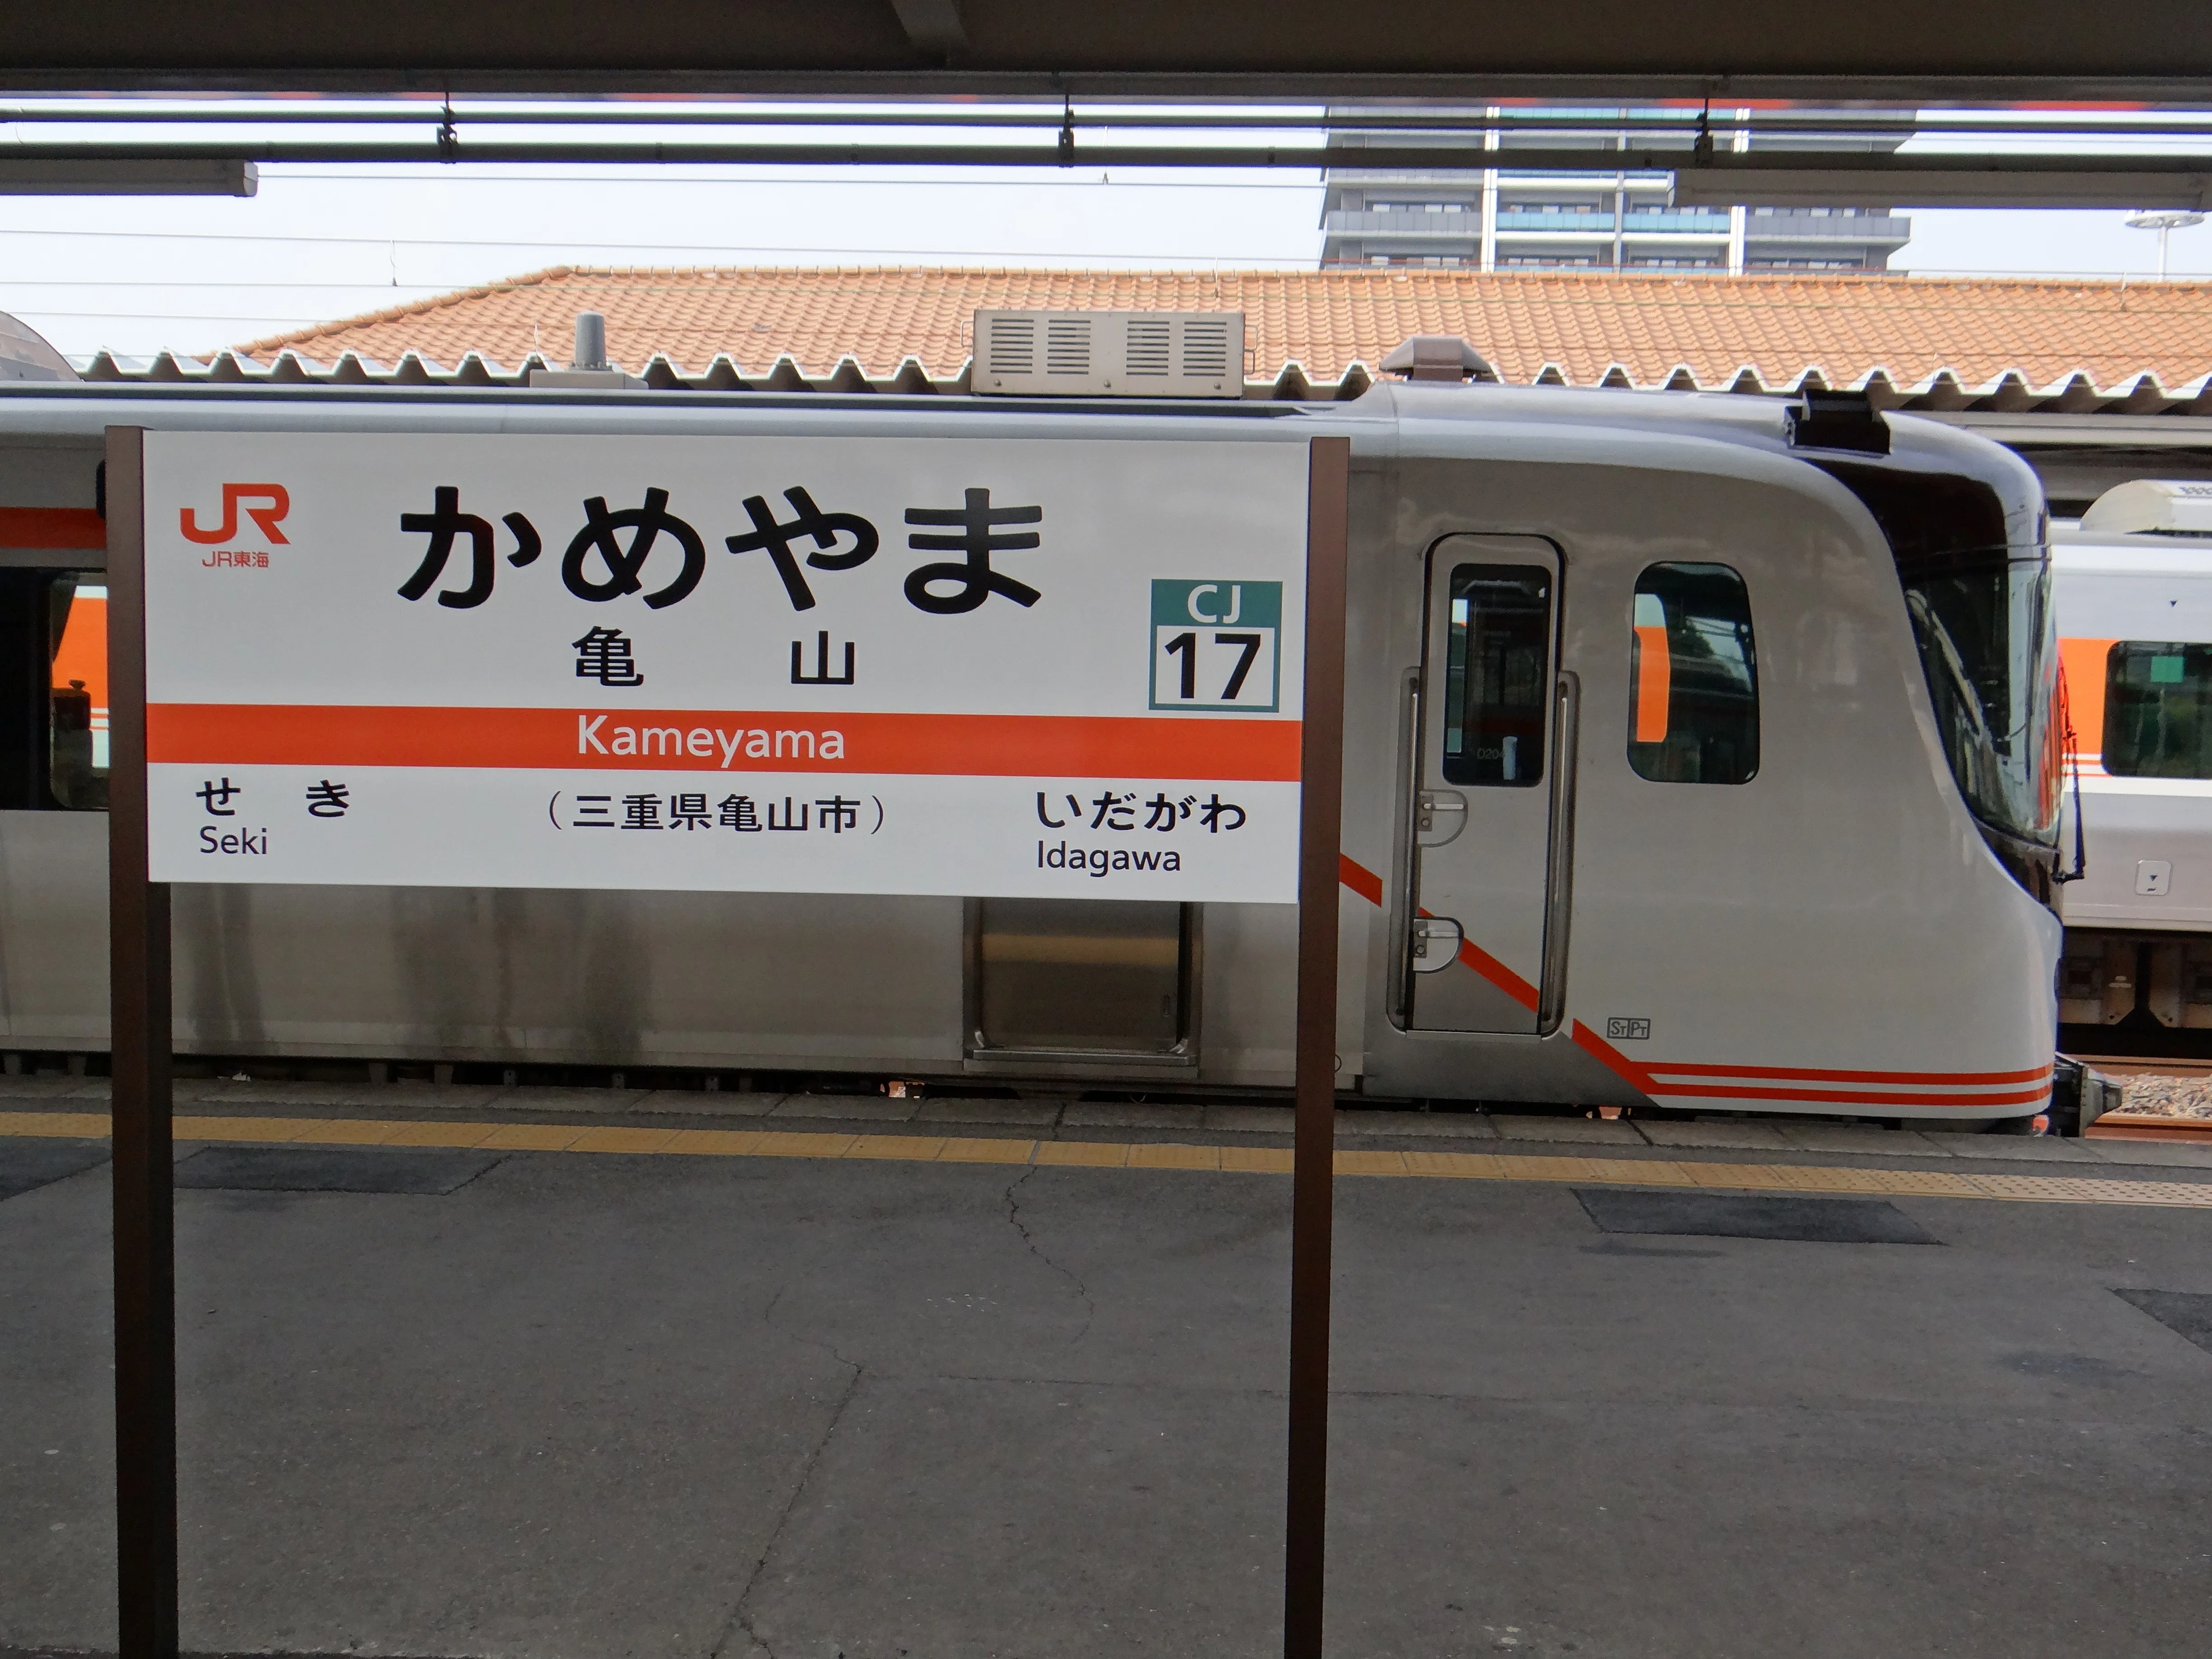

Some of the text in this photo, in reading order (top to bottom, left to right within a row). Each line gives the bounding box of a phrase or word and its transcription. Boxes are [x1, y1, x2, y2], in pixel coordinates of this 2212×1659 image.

[180, 483, 291, 545] JR
[202, 550, 269, 568] JR東海
[397, 485, 1043, 614] かめやま
[1187, 584, 1241, 624] CJ
[1164, 632, 1261, 700] 17
[578, 714, 845, 769] Kameyama
[1036, 791, 1247, 834] いだがわ
[199, 825, 267, 855] Seki
[1038, 840, 1181, 877] Idagawa
